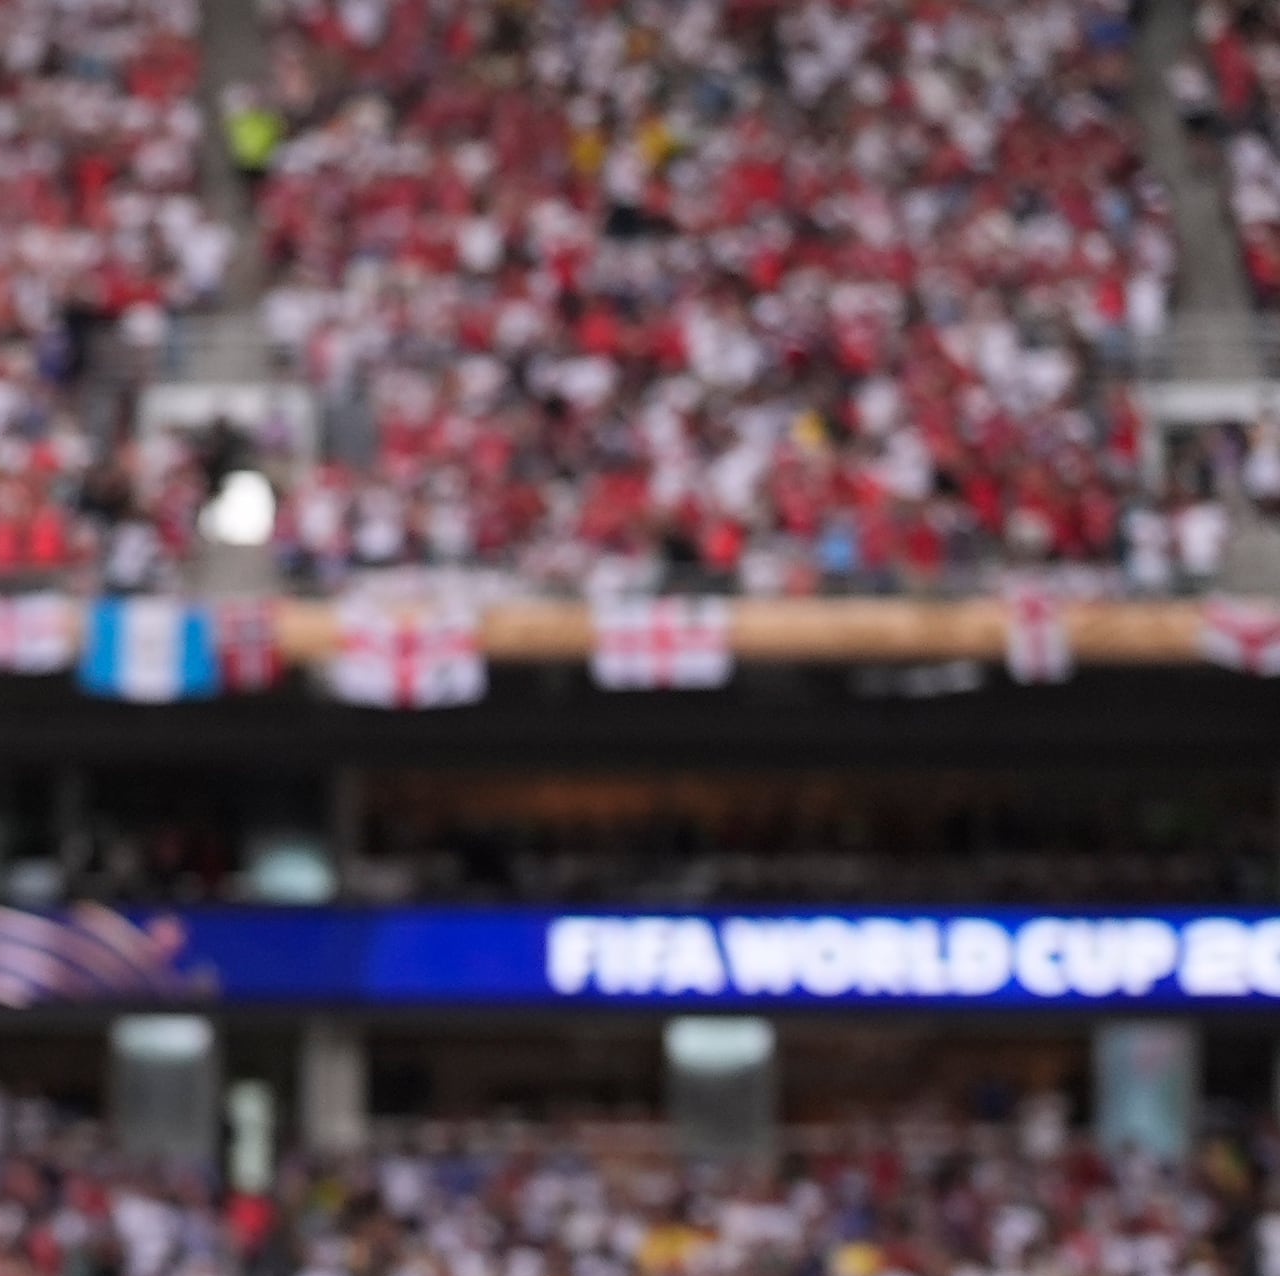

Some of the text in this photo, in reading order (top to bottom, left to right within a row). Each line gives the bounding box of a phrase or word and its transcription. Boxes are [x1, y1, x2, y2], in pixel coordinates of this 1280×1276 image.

[547, 916, 729, 996] FIFA
[721, 916, 1012, 997] WORLD
[1014, 916, 1179, 998] CUP
